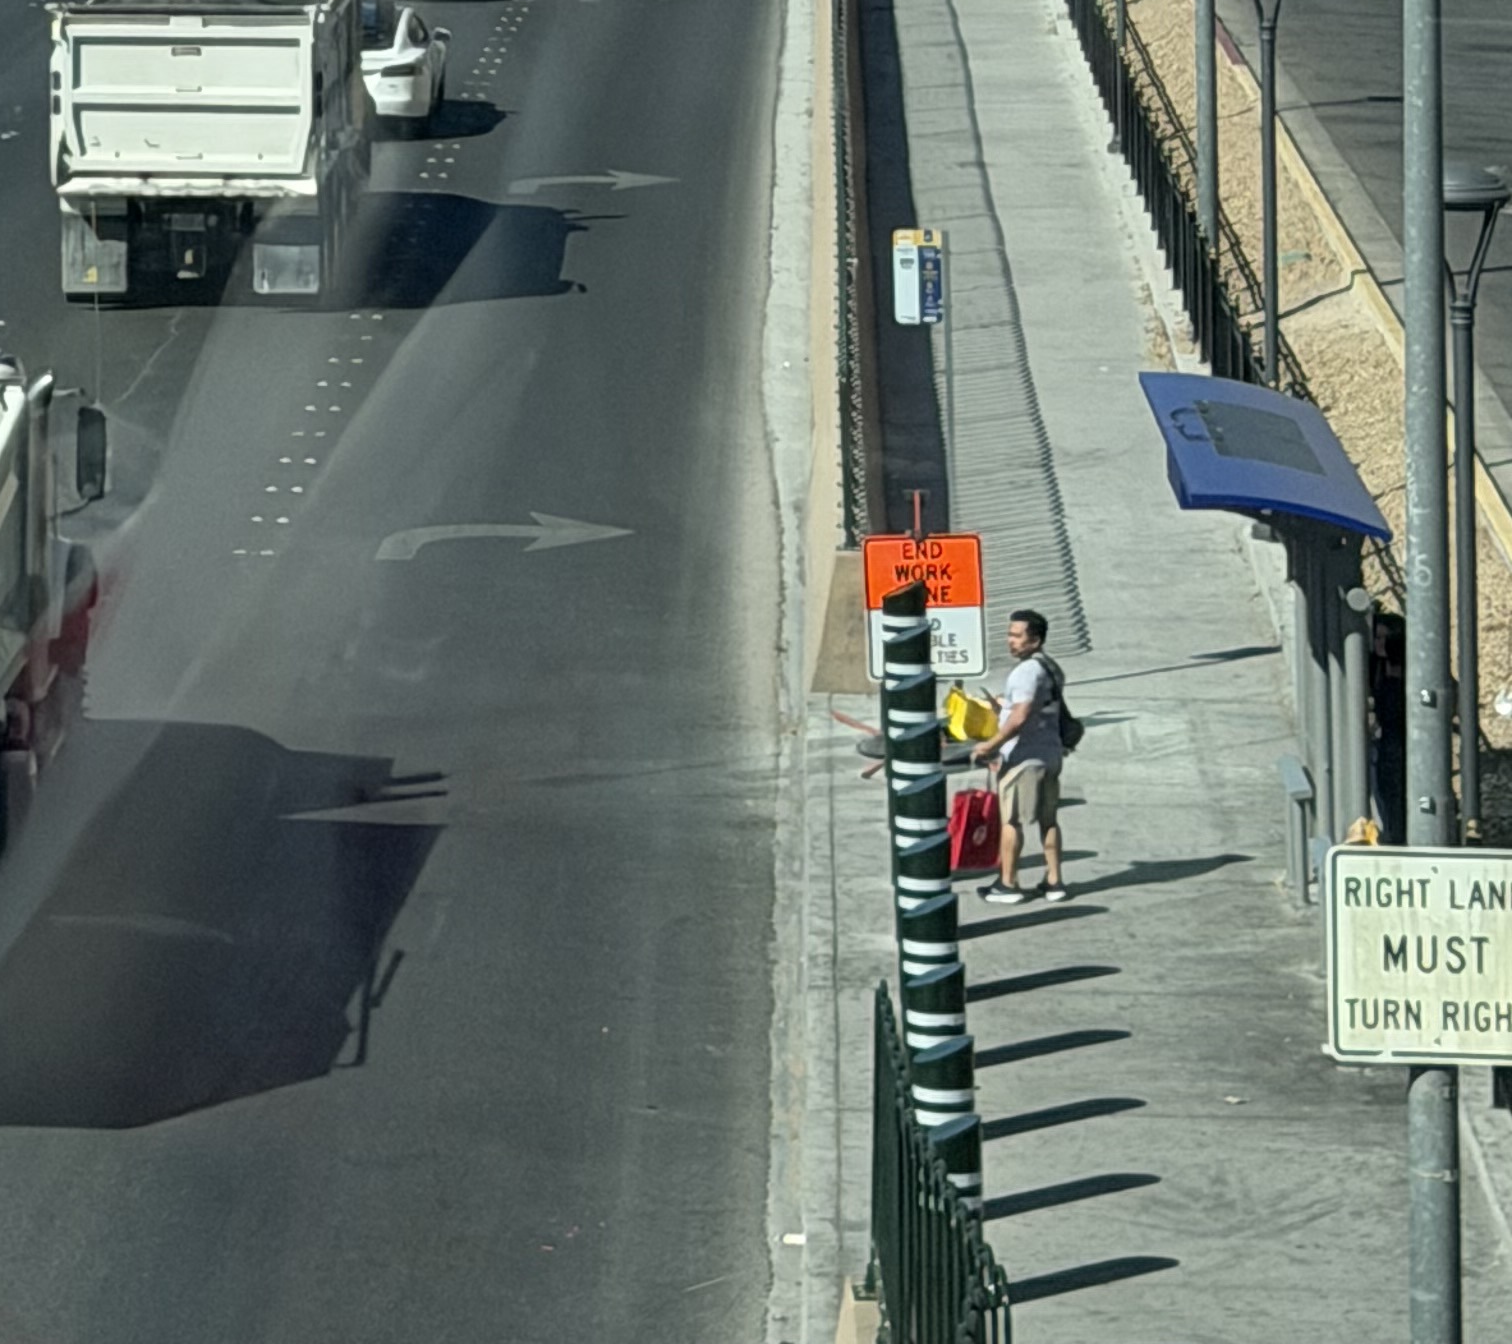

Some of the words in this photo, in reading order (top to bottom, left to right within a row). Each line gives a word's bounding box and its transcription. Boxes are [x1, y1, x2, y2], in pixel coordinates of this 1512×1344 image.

[902, 541, 943, 560] END
[894, 562, 953, 582] WORK
[1344, 876, 1431, 908] RIGHT
[1449, 879, 1512, 910] LAN
[1383, 934, 1490, 974] MUST
[1344, 997, 1423, 1030] TURN
[1442, 999, 1512, 1032] RIGH
